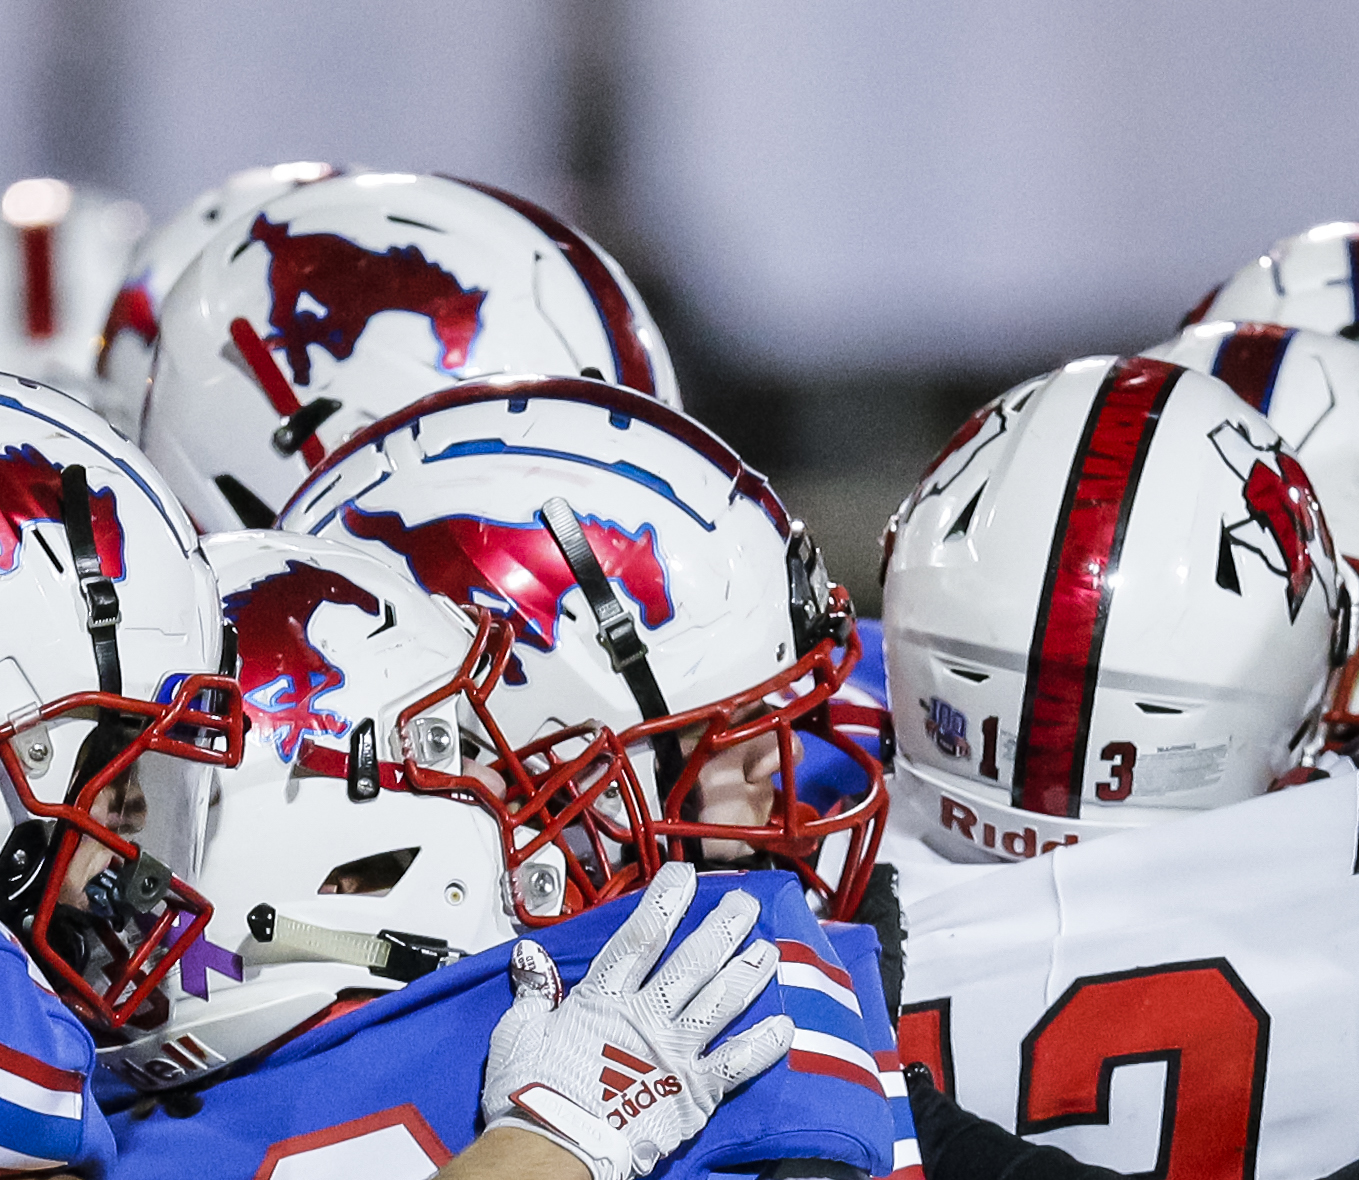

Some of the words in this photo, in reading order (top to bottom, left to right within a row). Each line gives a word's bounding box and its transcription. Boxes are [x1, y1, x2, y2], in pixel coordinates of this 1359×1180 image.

[979, 715, 1000, 781] 1
[1096, 741, 1138, 802] 3
[606, 1074, 683, 1131] adidas
